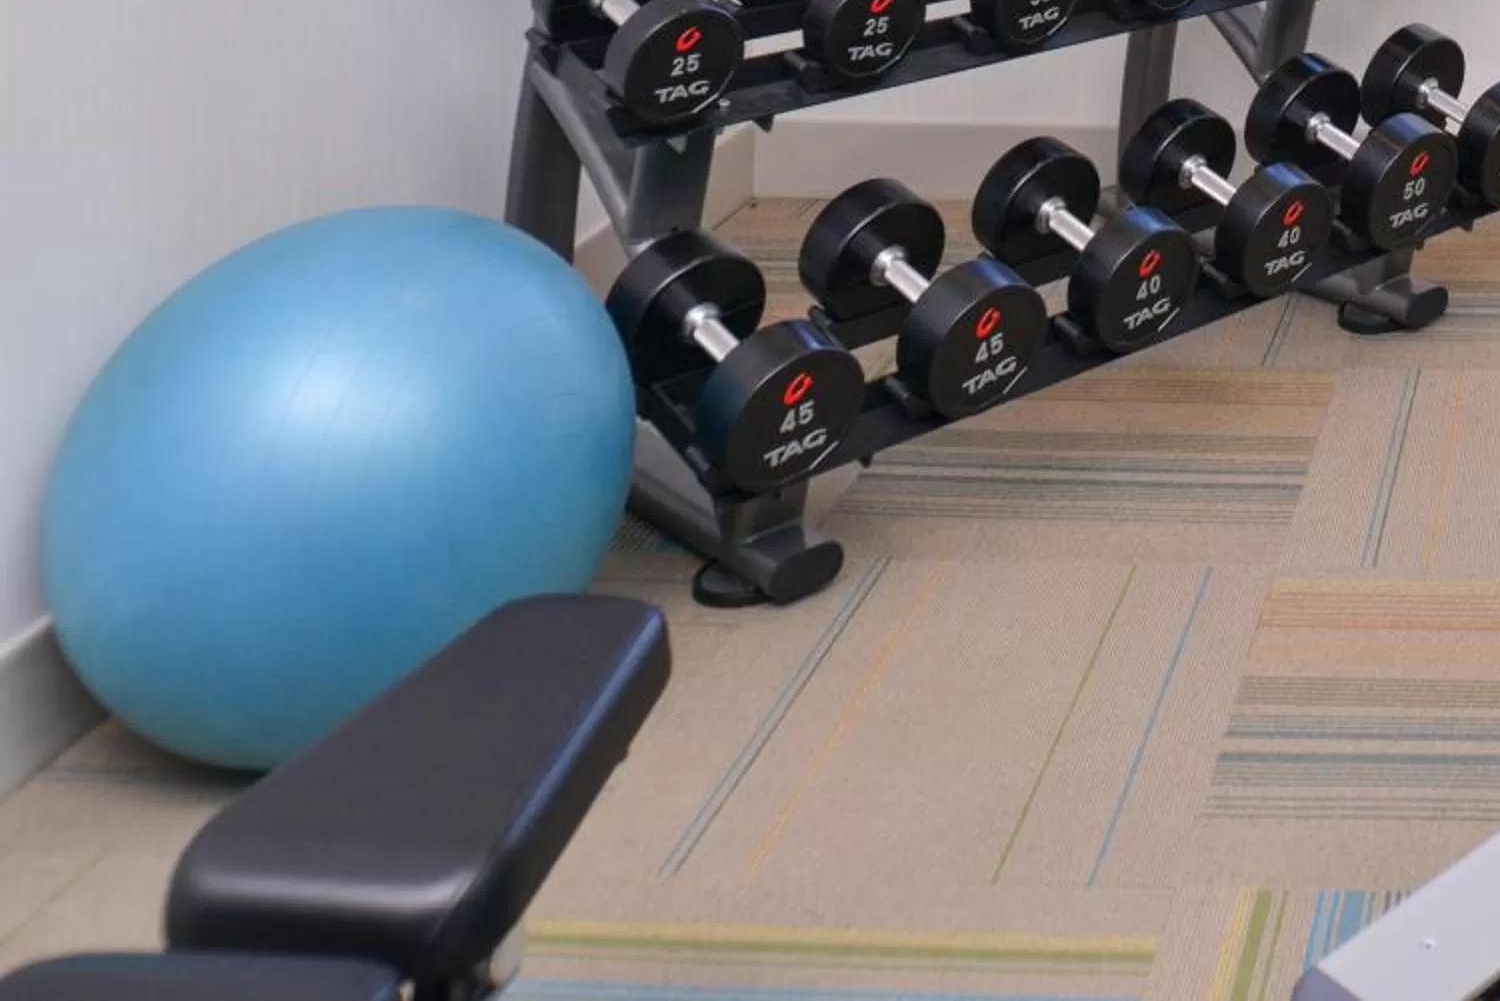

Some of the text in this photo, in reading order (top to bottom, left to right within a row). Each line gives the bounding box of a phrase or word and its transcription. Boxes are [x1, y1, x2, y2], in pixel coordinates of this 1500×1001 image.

[864, 16, 889, 37] 25
[1018, 6, 1060, 30] TAG
[848, 42, 894, 60] TAG
[671, 53, 701, 77] 25
[654, 80, 710, 104] TAG
[1403, 177, 1425, 200] 50
[1389, 202, 1428, 228] TAG
[1277, 226, 1300, 248] 40
[1264, 250, 1306, 276] TAG
[1136, 275, 1161, 301] 40
[1123, 297, 1171, 330] TAG
[975, 332, 1004, 363] 45
[962, 355, 1017, 395] TAG
[780, 399, 814, 434] 45
[763, 428, 828, 468] TAG
